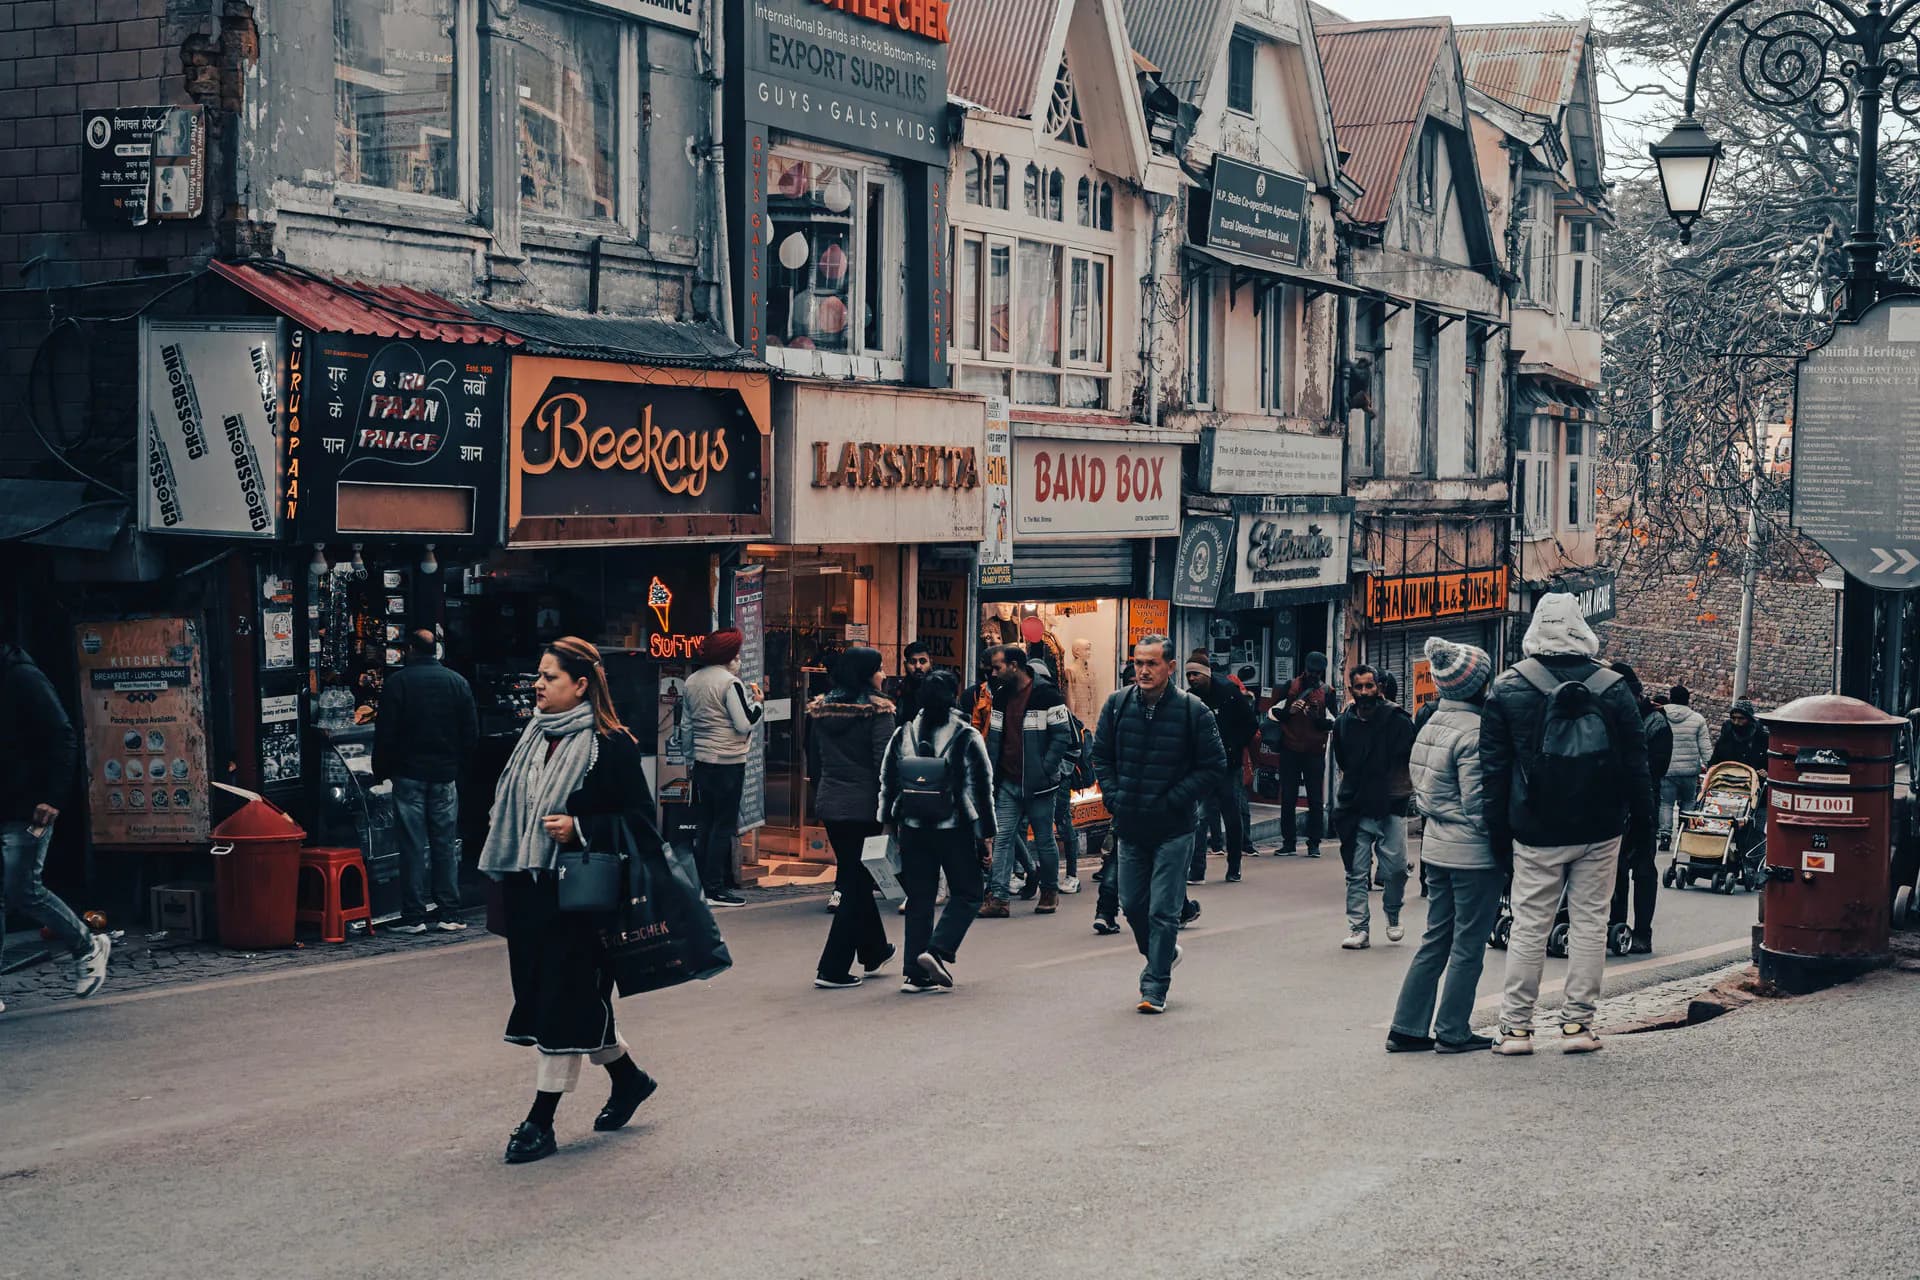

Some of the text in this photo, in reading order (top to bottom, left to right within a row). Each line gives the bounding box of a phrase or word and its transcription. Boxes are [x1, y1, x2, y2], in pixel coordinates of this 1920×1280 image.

[755, 4, 816, 34] International
[818, 21, 849, 44] Brands
[850, 34, 860, 48] at
[861, 34, 882, 53] Rock
[884, 42, 915, 64] Bottom
[916, 52, 937, 71] Price
[768, 32, 928, 104] EXPORT SURPLUS
[758, 82, 936, 144] GUYS GALS KIDS
[188, 115, 198, 209] Offer of the Month
[751, 136, 762, 201] GUYS
[1228, 192, 1241, 207] State
[932, 183, 940, 278] STYLE
[1220, 216, 1235, 230] Rural
[1235, 220, 1267, 238] Development
[1267, 229, 1280, 241] Bank
[1254, 212, 1260, 223] &
[751, 214, 761, 280] GALS
[751, 291, 760, 357] KIDS
[932, 289, 942, 364] CHEK
[1817, 346, 1916, 360] Shimla Heritage
[290, 330, 303, 414] GURU
[327, 366, 348, 391] गुरु
[463, 374, 487, 396] लबों
[329, 395, 344, 418] के
[368, 394, 440, 422] PAAN
[465, 407, 482, 428] की
[322, 437, 346, 454] पान
[358, 429, 441, 451] PALACE
[460, 445, 484, 462] शान
[521, 392, 729, 497] Beekays
[286, 437, 301, 520] PAAN
[811, 441, 981, 489] LAKSHITA
[1033, 451, 1164, 503] BAND BOX
[1375, 576, 1488, 619] BHANU MULL & SONS
[919, 607, 959, 629] TYLE
[94, 671, 130, 681] BREAKFAST
[134, 670, 156, 679] LUNCH
[1796, 797, 1852, 811] 171001
